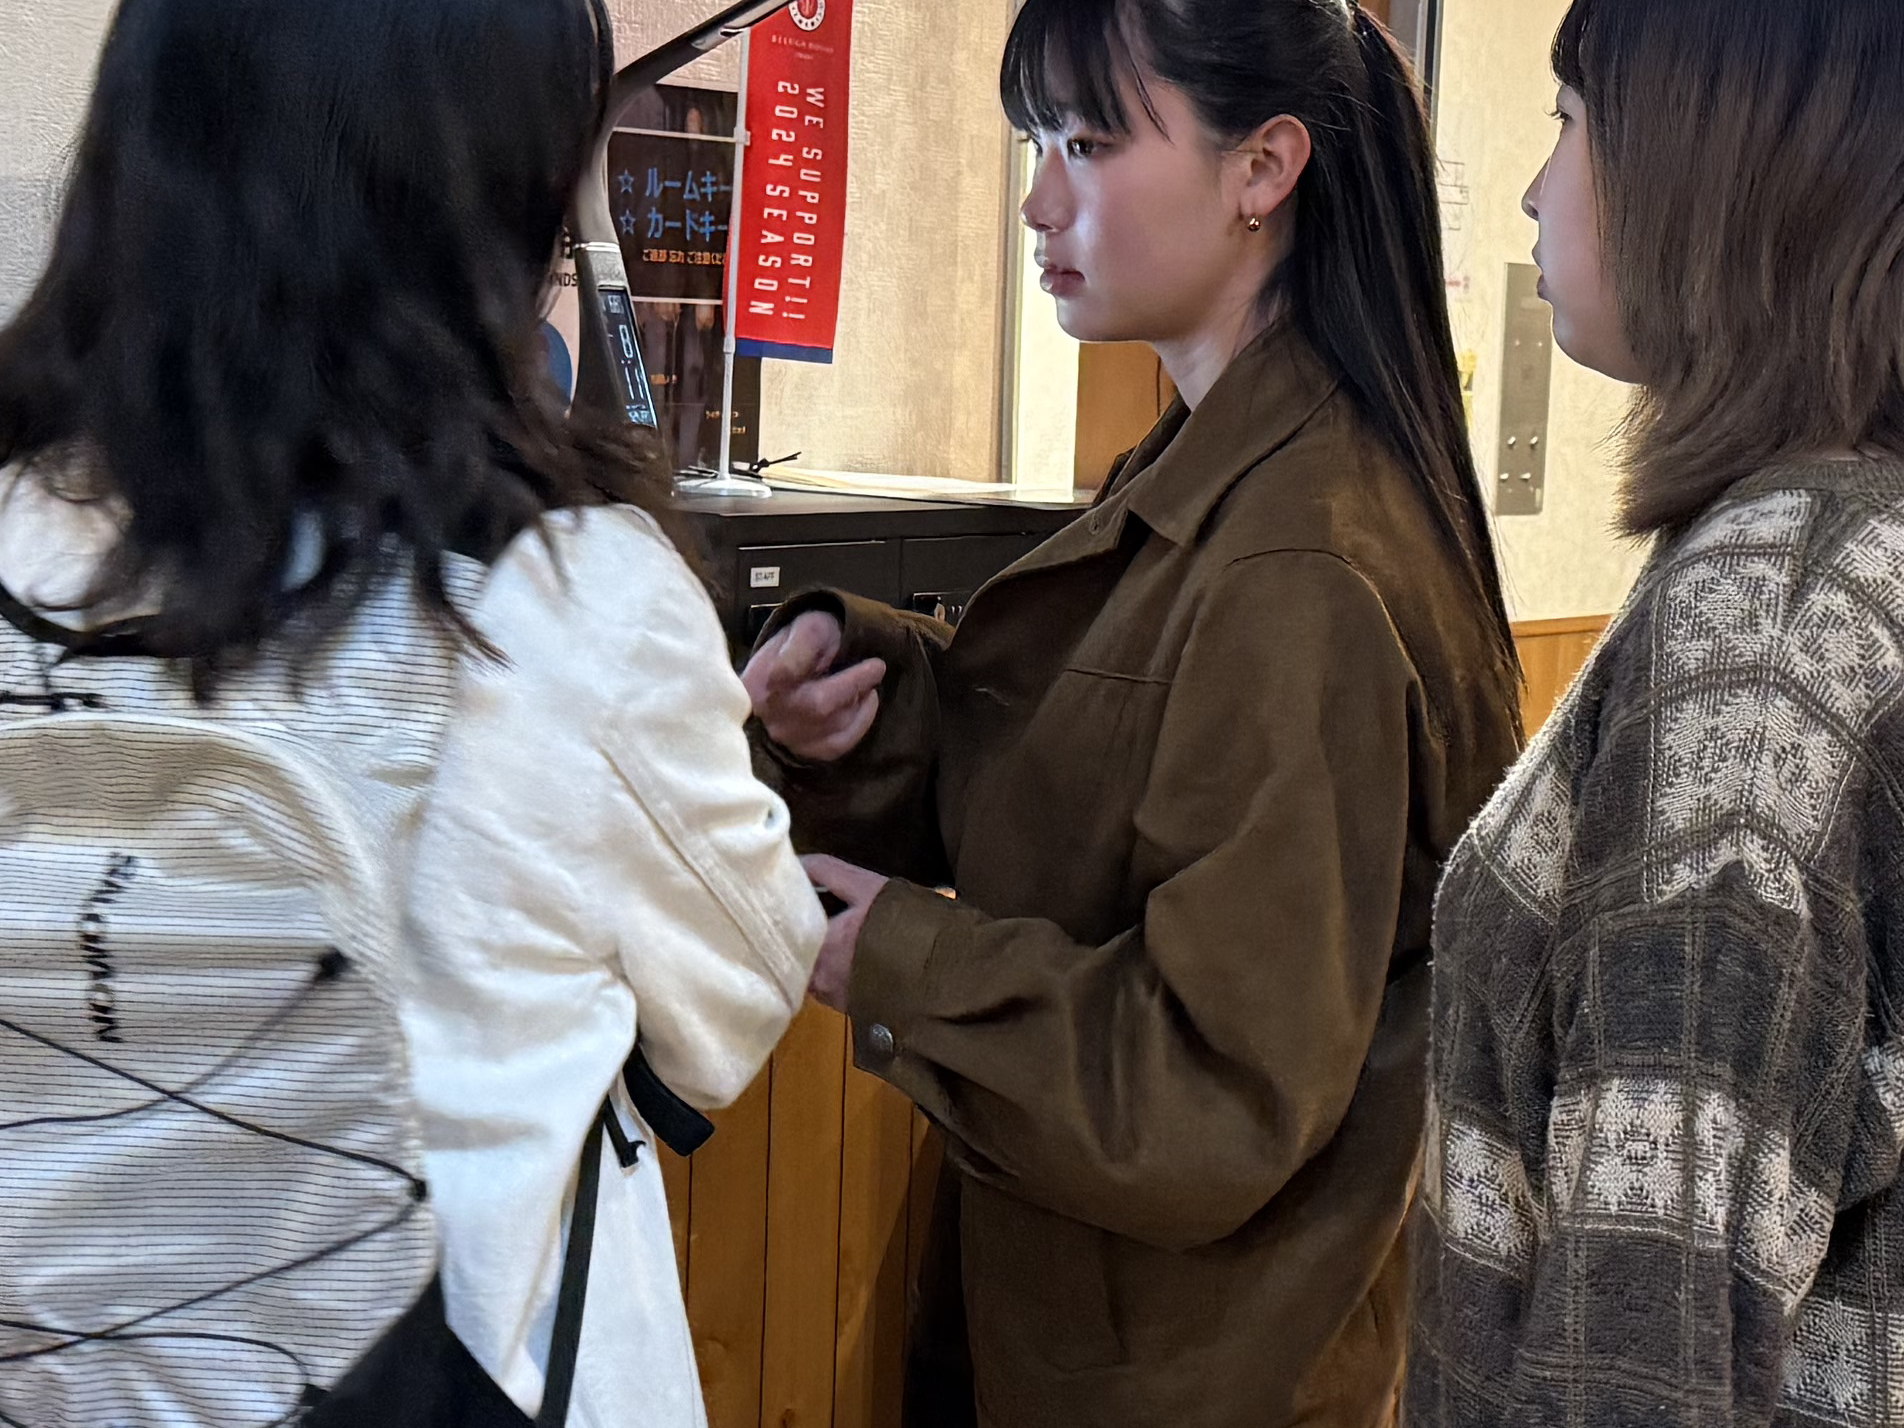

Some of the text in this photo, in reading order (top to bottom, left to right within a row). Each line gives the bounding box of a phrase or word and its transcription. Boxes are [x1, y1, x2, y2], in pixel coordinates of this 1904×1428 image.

[803, 87, 825, 130] WE
[644, 168, 734, 203] ルームキー
[748, 80, 800, 317] 2024 SEASON
[781, 147, 824, 320] SUPPORT!!
